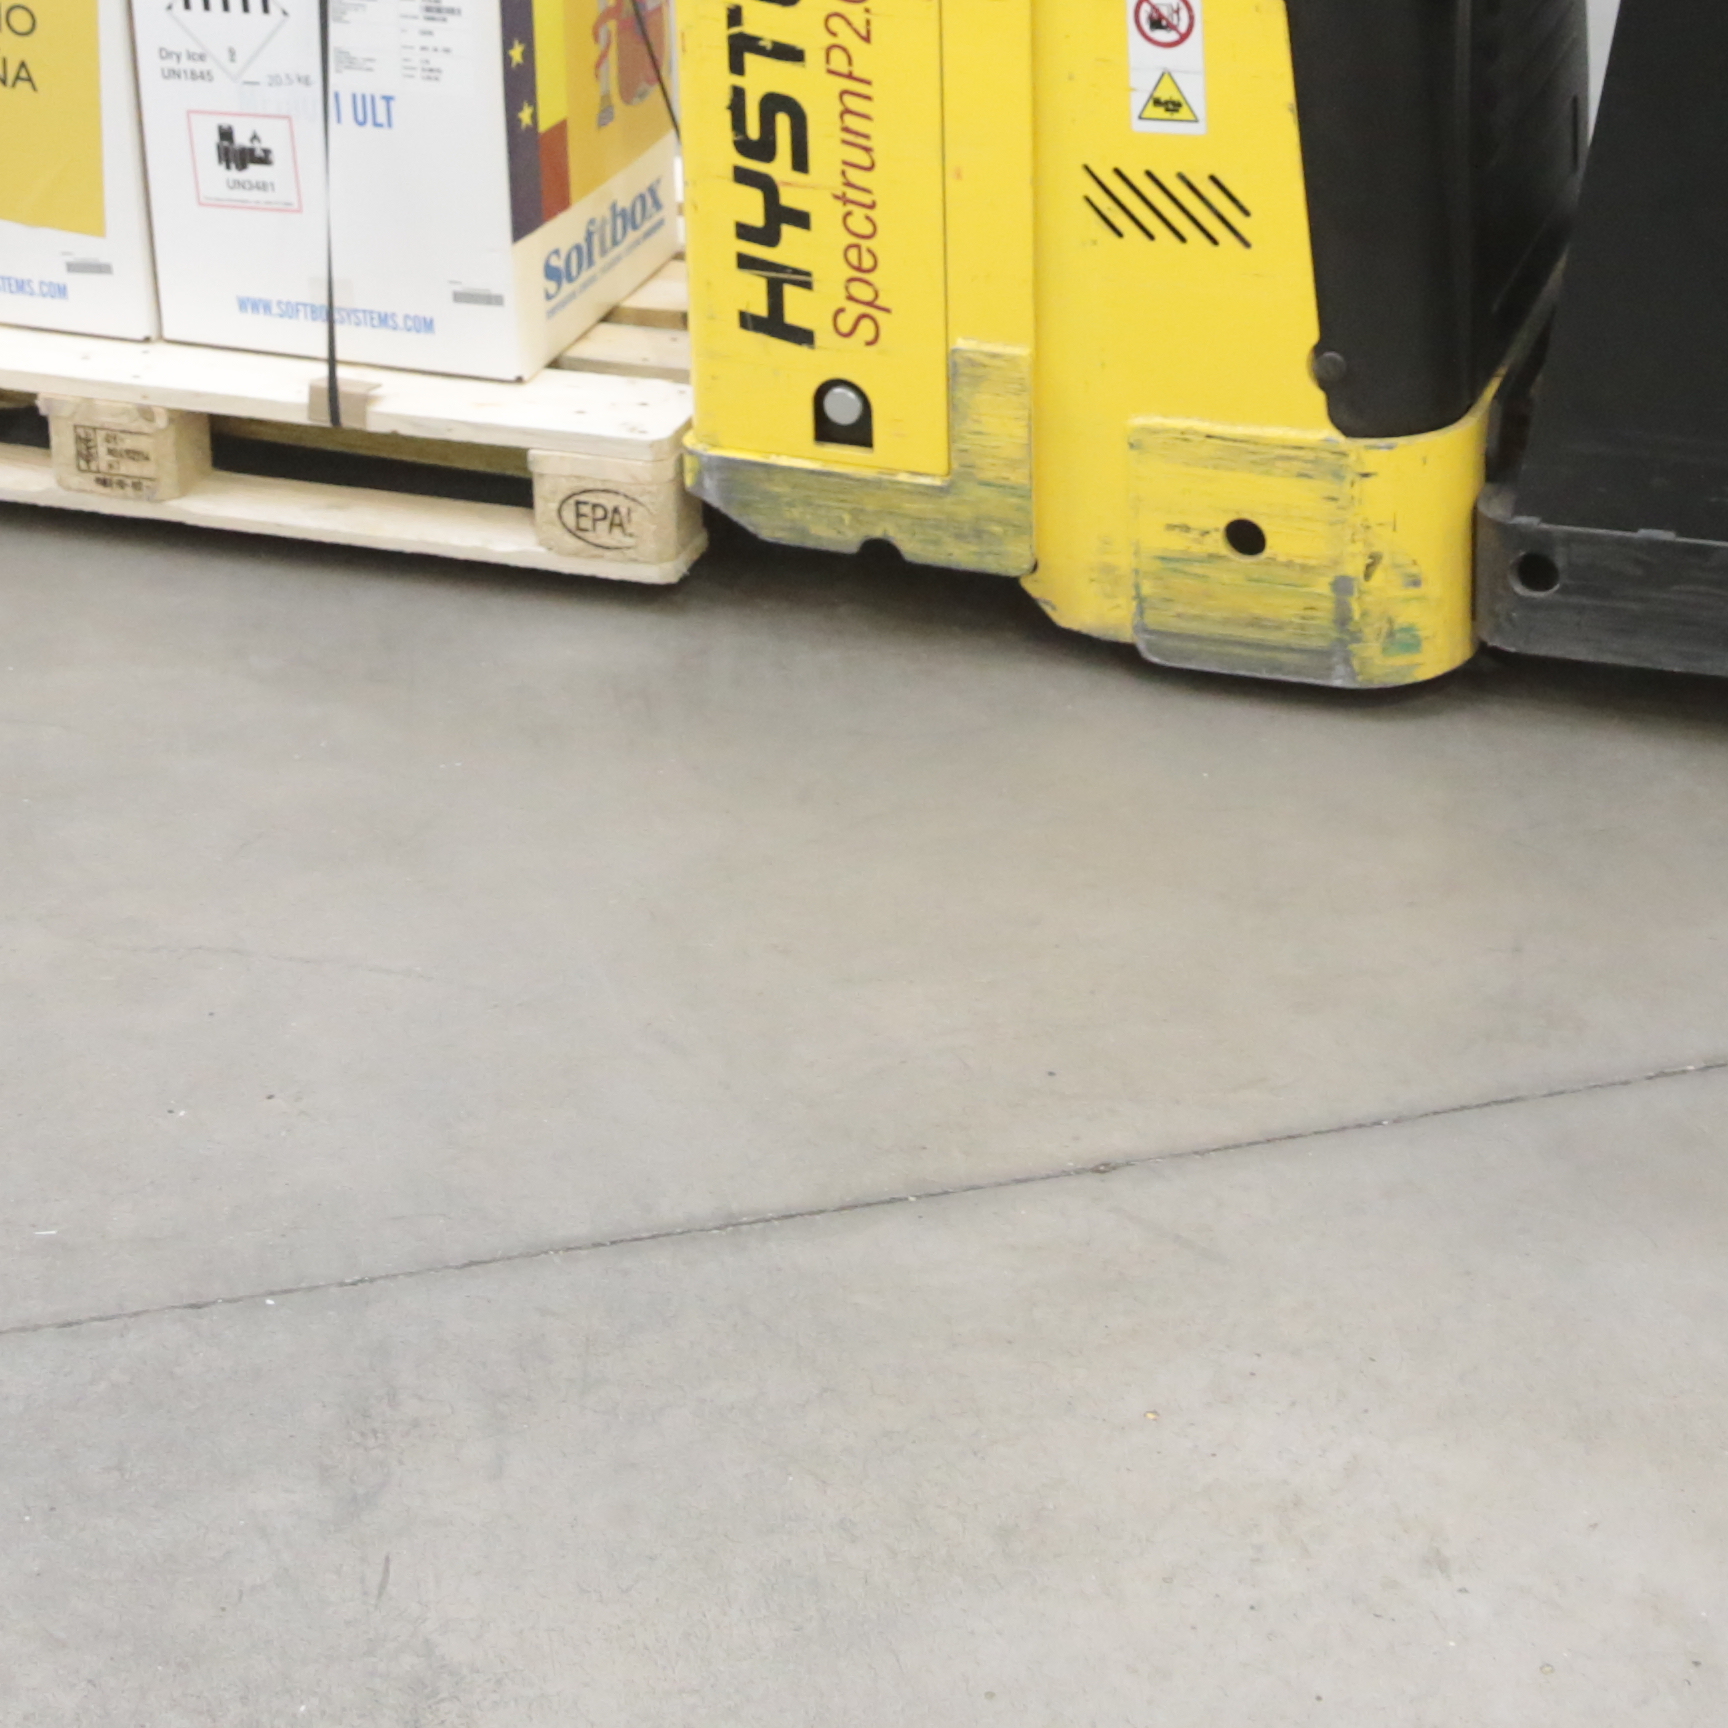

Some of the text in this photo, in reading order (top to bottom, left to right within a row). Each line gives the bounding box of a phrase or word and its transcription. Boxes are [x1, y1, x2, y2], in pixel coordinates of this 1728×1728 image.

[158, 46, 207, 64] Dry Ice
[352, 92, 395, 129] ULT
[544, 175, 663, 301] Softbox
[236, 294, 435, 334] WWW.SOFTBOSYSTEMS.COM
